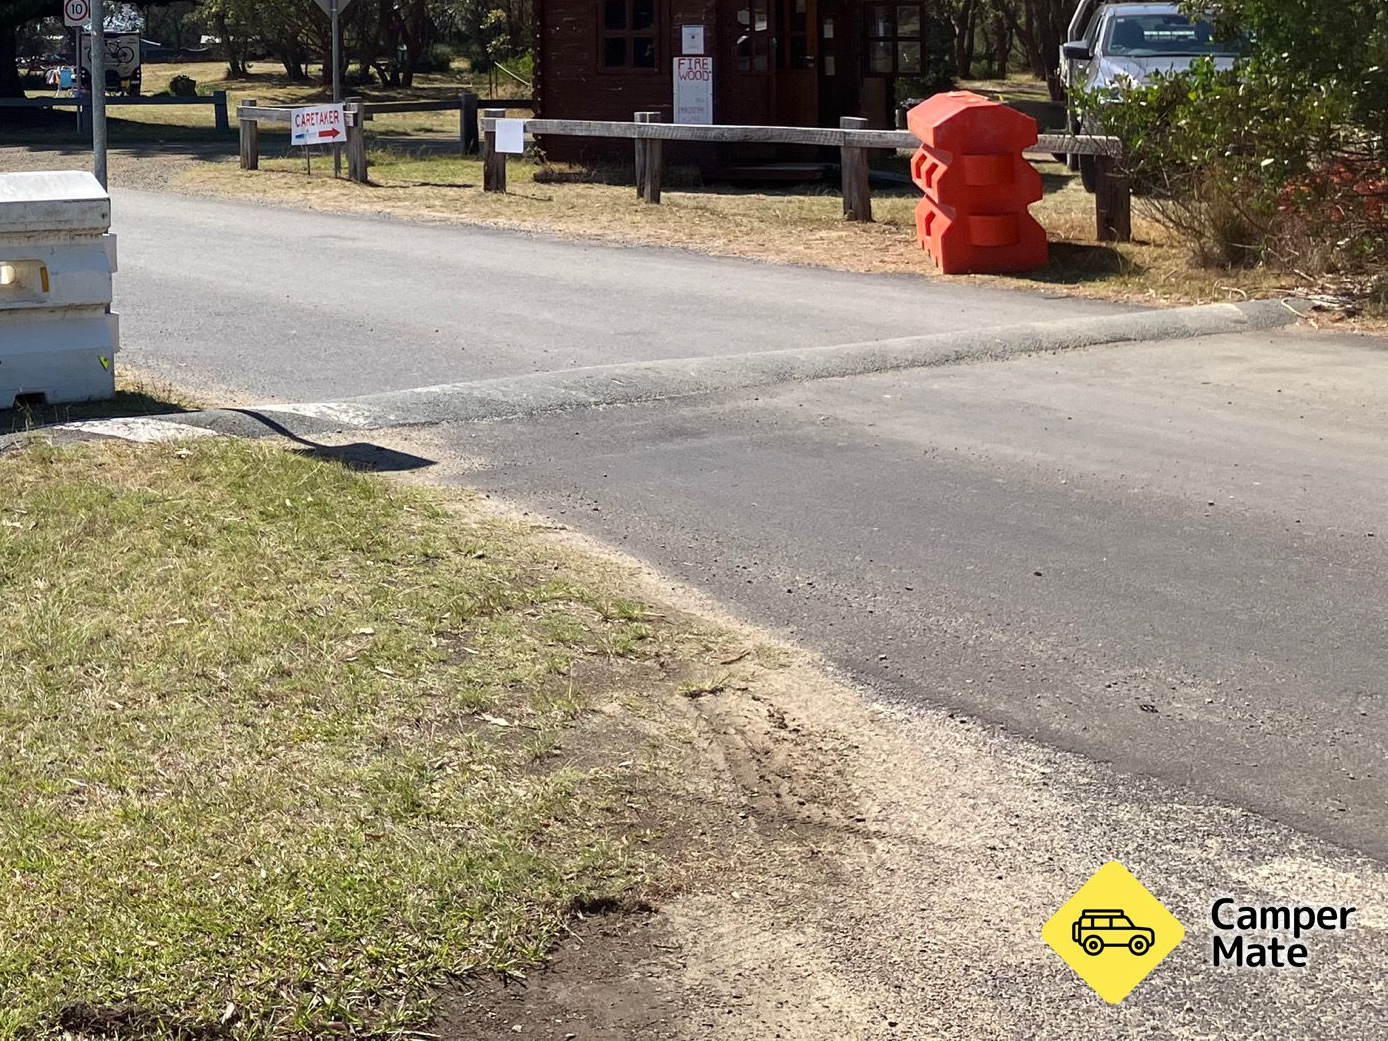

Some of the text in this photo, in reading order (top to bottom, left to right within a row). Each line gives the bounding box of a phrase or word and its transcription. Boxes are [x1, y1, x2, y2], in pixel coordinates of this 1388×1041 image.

[70, 3, 83, 15] 10
[678, 58, 708, 70] FIRE
[678, 70, 710, 81] WOOD
[295, 110, 340, 127] CARETAKER
